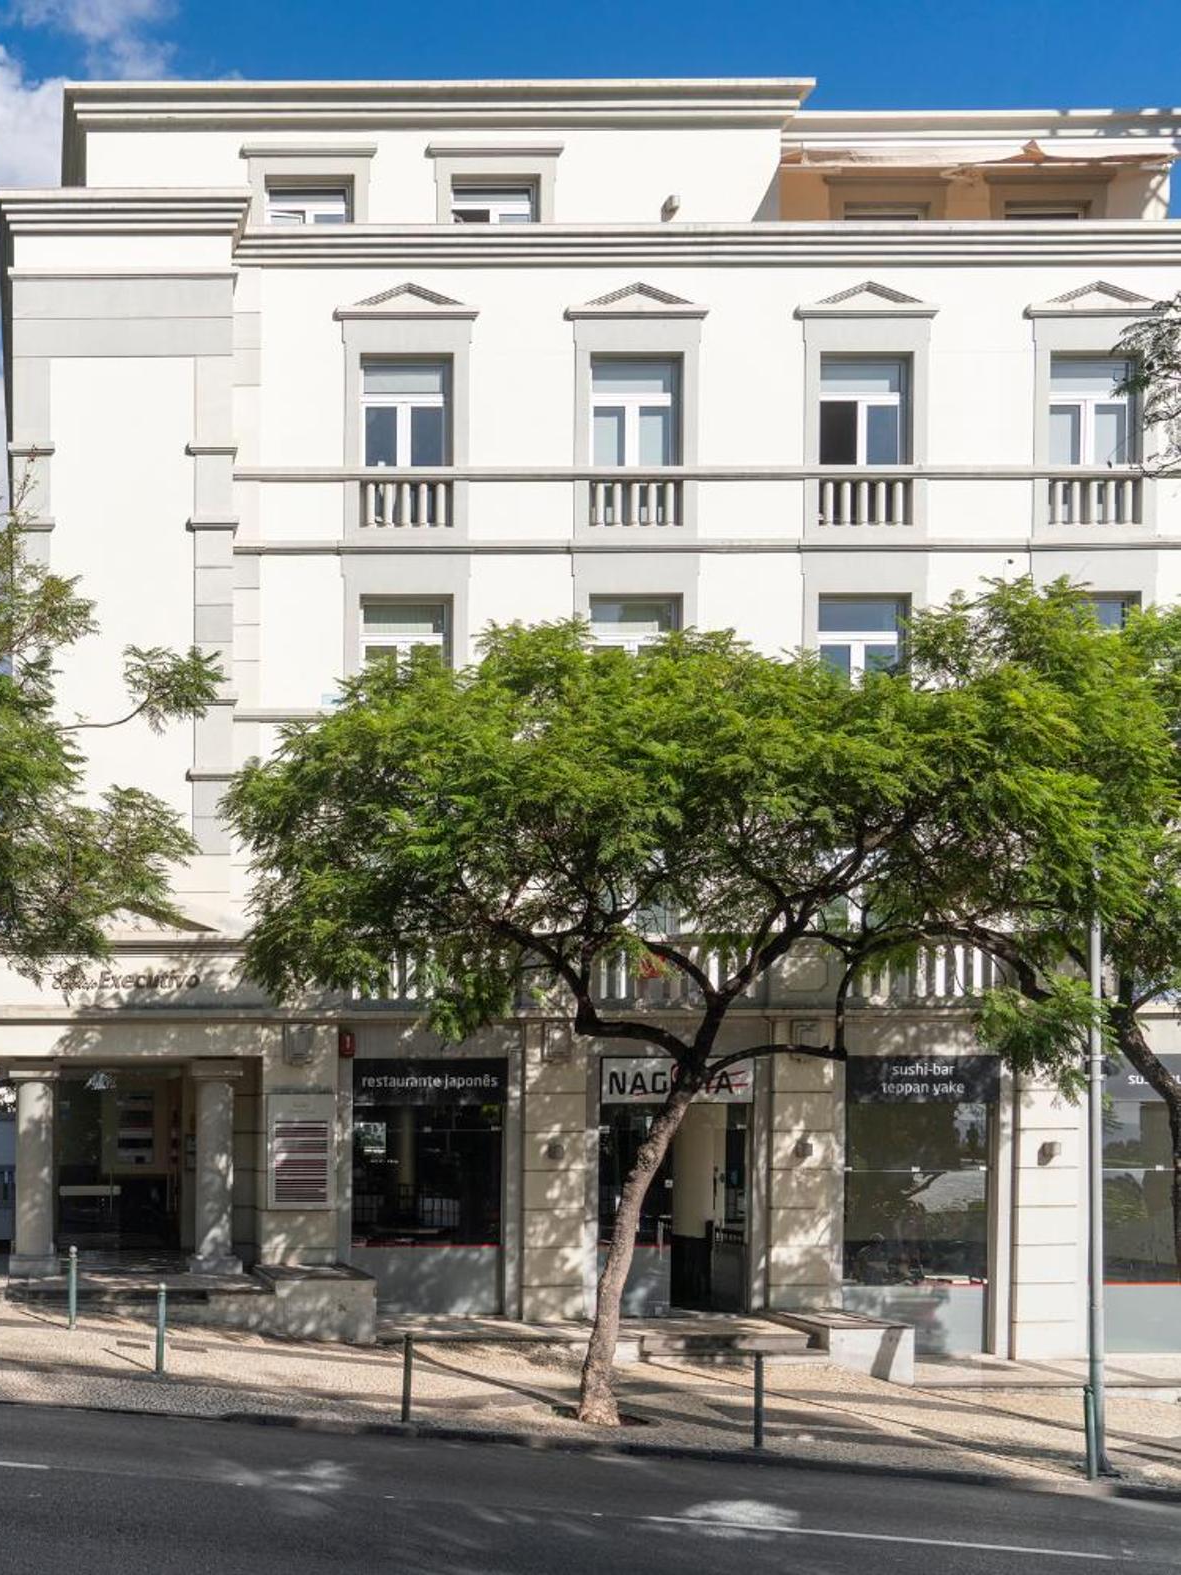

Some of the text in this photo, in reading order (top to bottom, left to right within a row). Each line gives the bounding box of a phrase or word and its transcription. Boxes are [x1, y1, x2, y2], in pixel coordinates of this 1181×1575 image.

[98, 970, 200, 989] Executivo
[892, 1063, 955, 1076] sushi-bar
[362, 1073, 499, 1090] restaurante japonês
[882, 1081, 965, 1096] teppan yake
